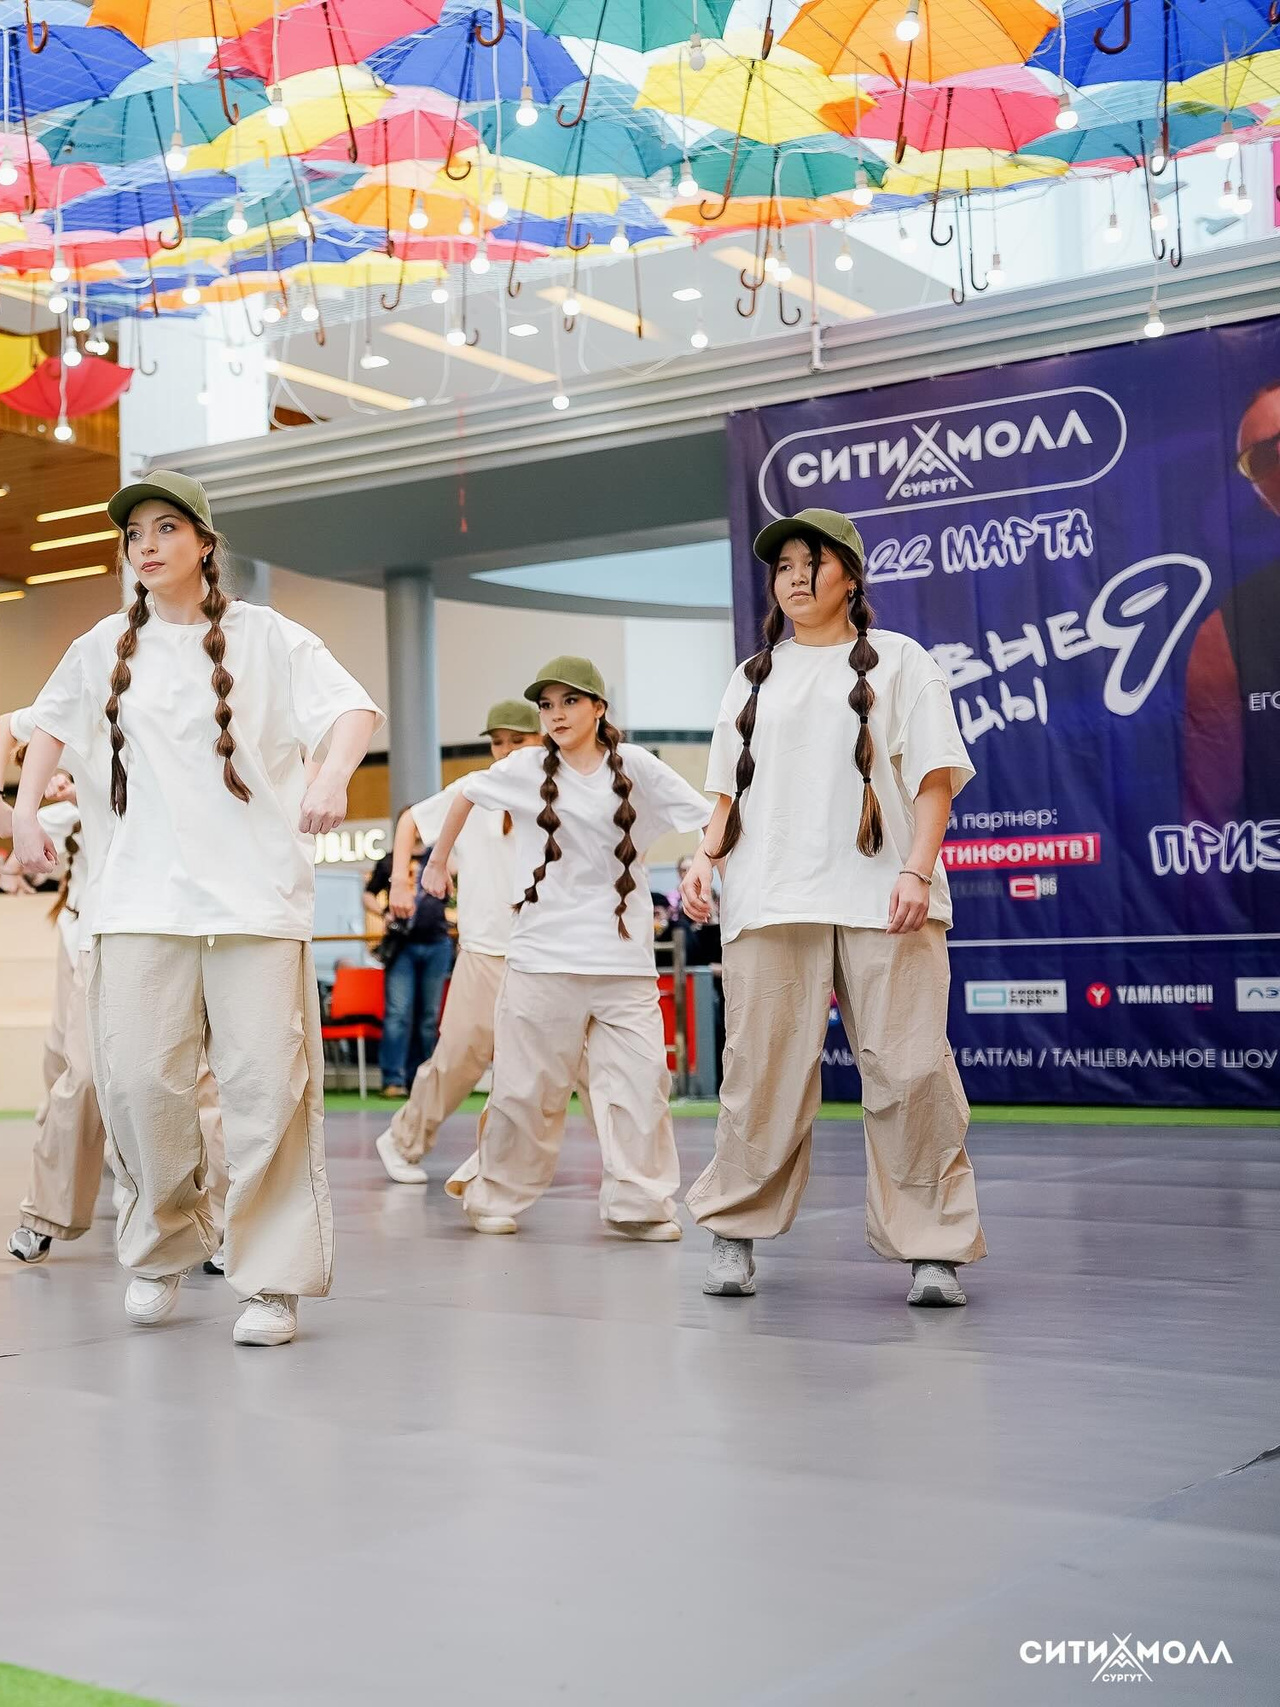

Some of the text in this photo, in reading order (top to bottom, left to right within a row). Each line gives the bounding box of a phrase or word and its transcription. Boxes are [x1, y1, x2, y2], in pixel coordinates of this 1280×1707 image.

[787, 410, 1093, 488] СИТИ МОЛЛ
[899, 476, 958, 498] СУРГУТ
[866, 508, 1094, 583] 22 МАРТА
[929, 611, 1093, 691] ВЫЕ
[959, 677, 1048, 744] ЦЫ
[962, 809, 1057, 831] партнер:
[943, 836, 1095, 865] ТИНФОРМТВ]
[1116, 985, 1214, 1004] YAMAGUCHI
[961, 1048, 1033, 1066] БАТТЛЫ
[1052, 1048, 1216, 1069] ТАНЦЕВАЛЬНОЕ
[1222, 1049, 1278, 1068] ШОУ
